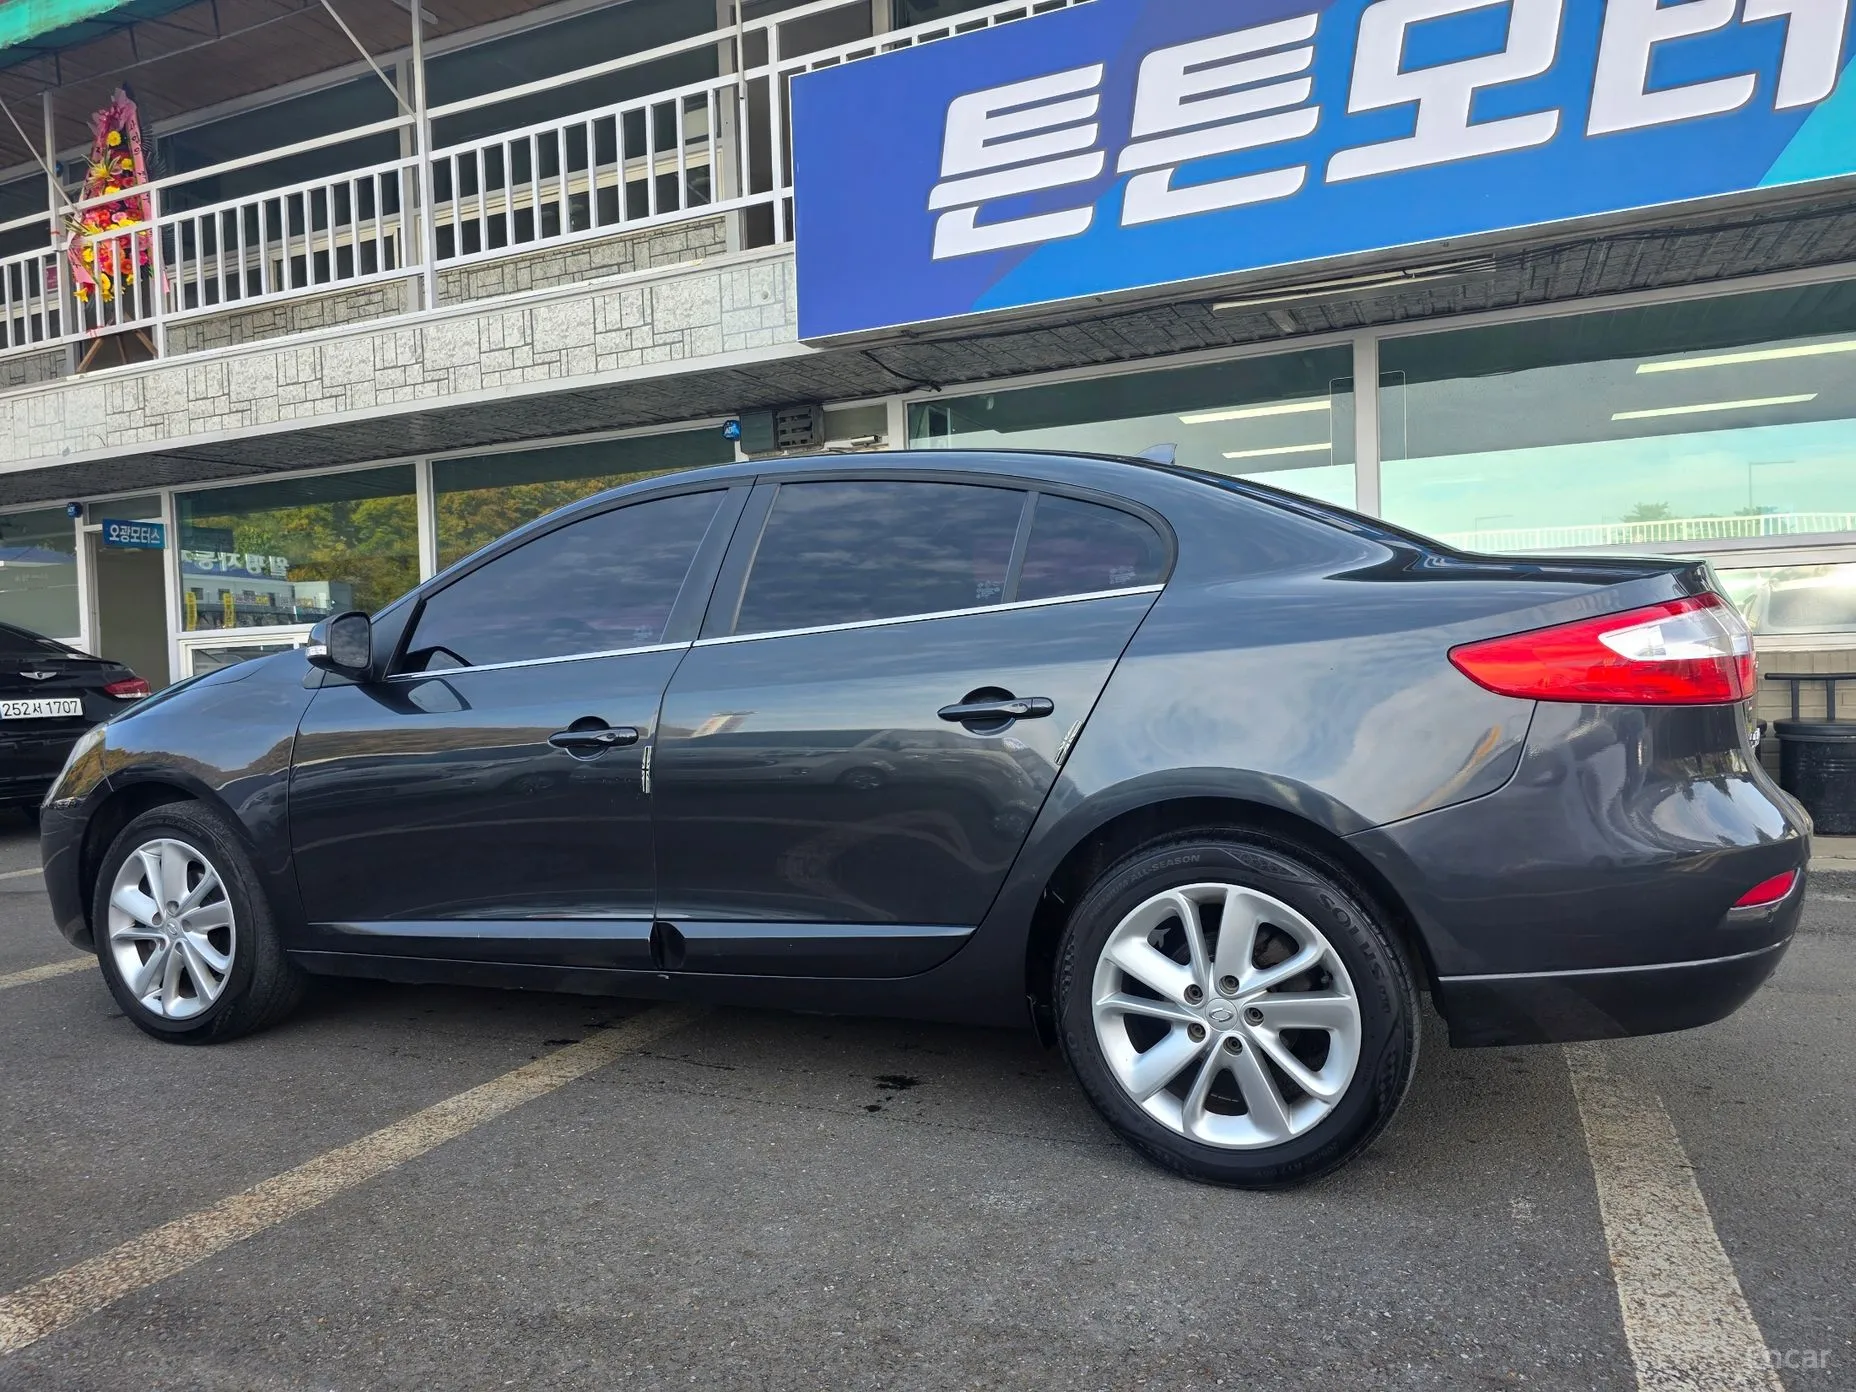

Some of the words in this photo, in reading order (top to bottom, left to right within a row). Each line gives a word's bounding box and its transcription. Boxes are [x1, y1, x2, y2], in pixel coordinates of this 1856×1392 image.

[929, 0, 1847, 260] 튼튼모터
[109, 524, 160, 544] 오광모터스
[45, 700, 78, 714] 1707
[1131, 854, 1201, 884] ALL-SEASON
[1316, 892, 1386, 981] SOLUS
